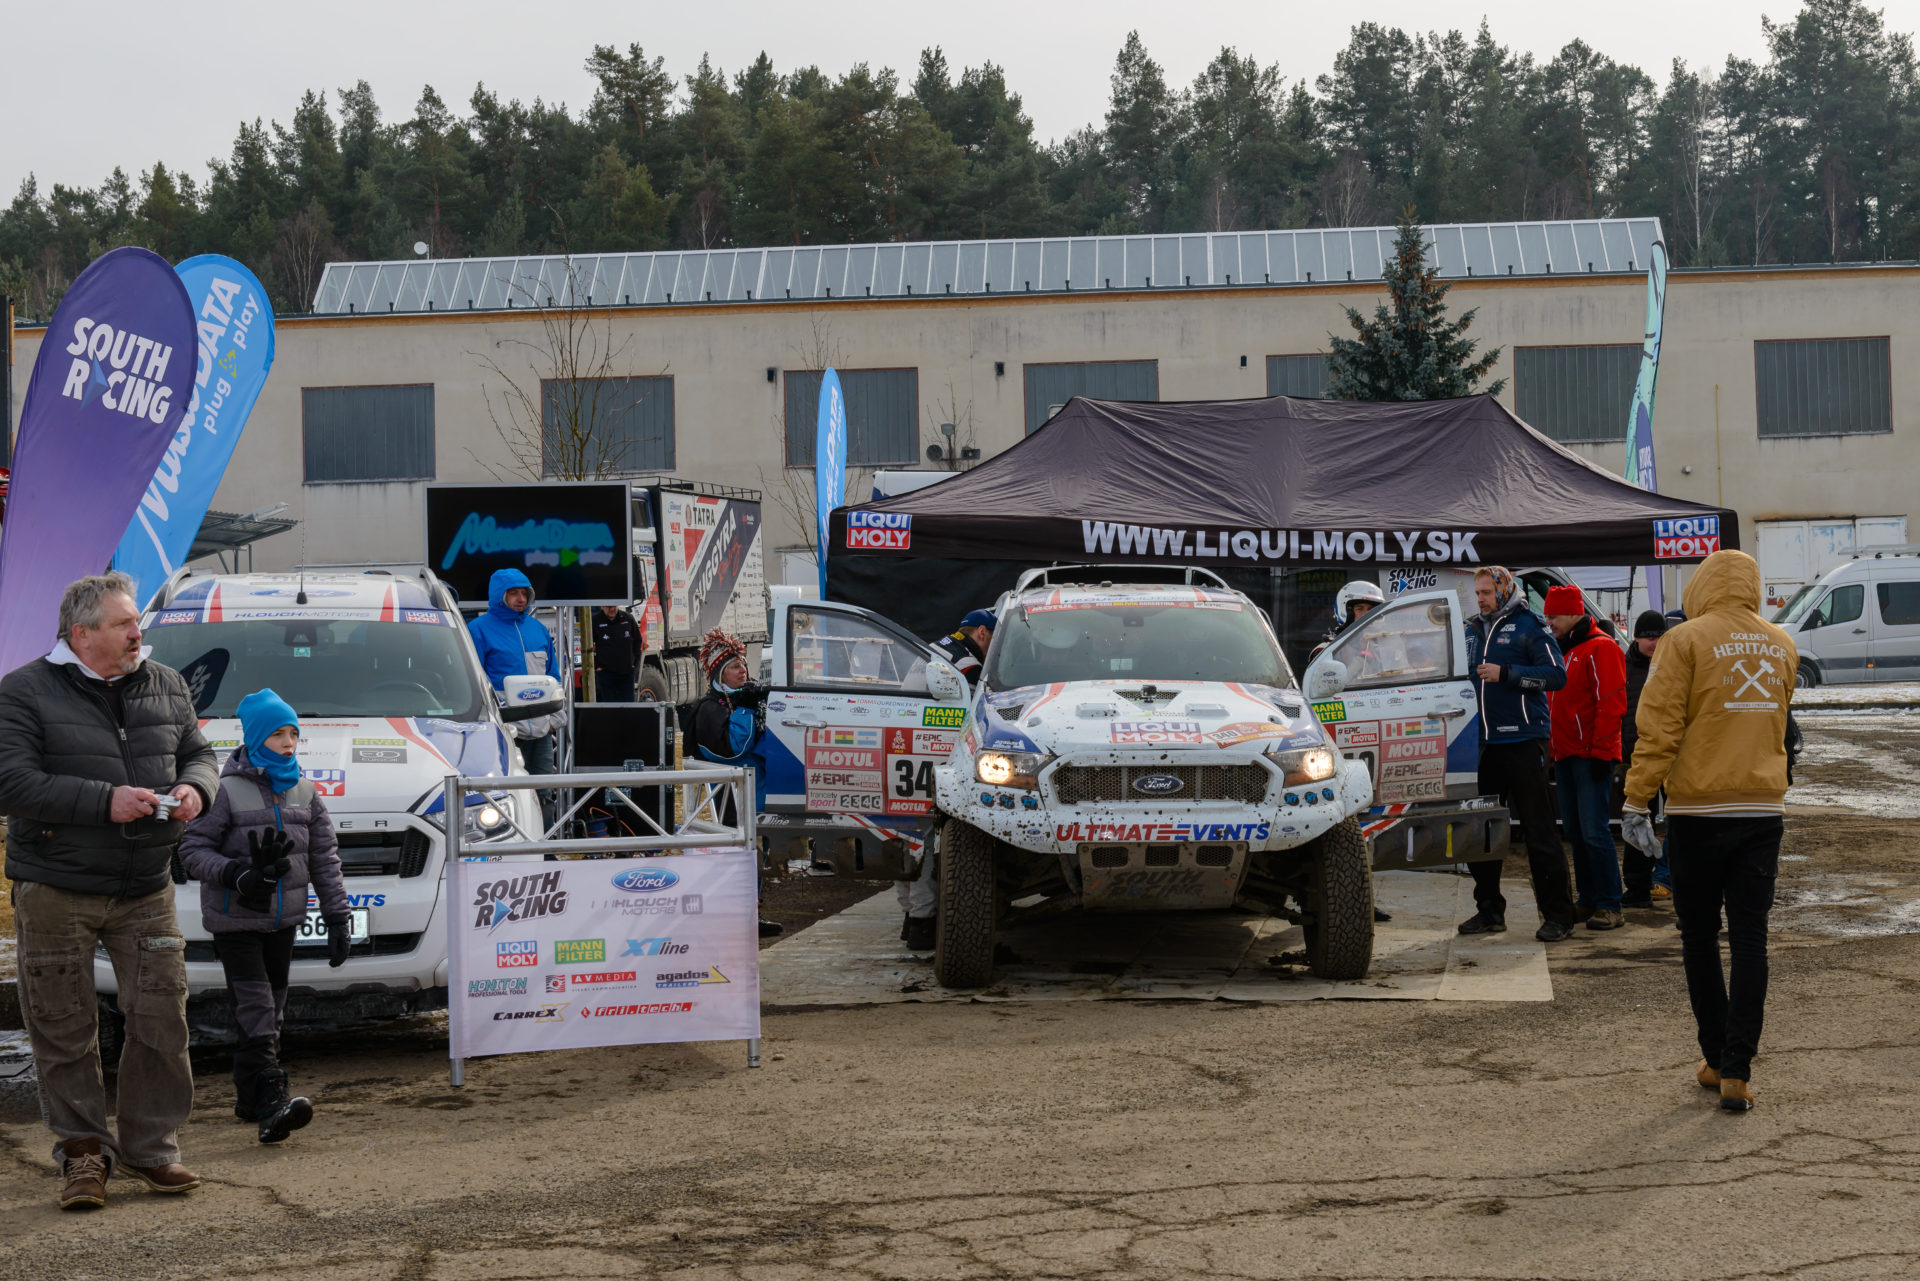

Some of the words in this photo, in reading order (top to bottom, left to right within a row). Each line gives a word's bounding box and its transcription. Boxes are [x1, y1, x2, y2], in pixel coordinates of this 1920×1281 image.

[66, 317, 173, 382] SOUTH
[203, 378, 232, 435] plug
[233, 293, 259, 349] play
[693, 507, 715, 526] TATRA
[850, 512, 908, 528] LIQUI
[1657, 517, 1716, 538] LIQUI
[850, 529, 909, 547] MOLY
[1082, 519, 1481, 562] WWW.LIQUI-MOLY.SK
[1657, 537, 1718, 558] MOLY
[693, 508, 737, 621] BUGGYRA
[1769, 586, 1775, 597] 8
[1730, 632, 1769, 641] GOLDEN
[1713, 642, 1787, 661] HERITAGE
[925, 707, 964, 717] MANN
[924, 716, 962, 726] FILTER
[1115, 722, 1200, 732] LIQUI
[1115, 732, 1197, 742] MOLY
[1212, 730, 1239, 740] 340
[1352, 734, 1376, 743] MOTUL
[1388, 740, 1439, 759] MOTUL
[814, 751, 875, 767] MOTUL
[1144, 777, 1172, 790] Ford
[890, 801, 927, 812] MOTUL
[623, 871, 667, 888] Ford
[474, 870, 561, 905] SOUTH
[613, 896, 678, 908] HLOUCH
[621, 906, 677, 916] MOTORS
[498, 941, 536, 954] LIQUI
[557, 940, 602, 951] MANN
[498, 953, 537, 967] MOLY
[557, 950, 602, 962] FILTER
[656, 970, 709, 981] agados
[467, 976, 528, 992] HONITON
[467, 990, 508, 998] PROFESSIONAL
[509, 988, 527, 996] TOOLS
